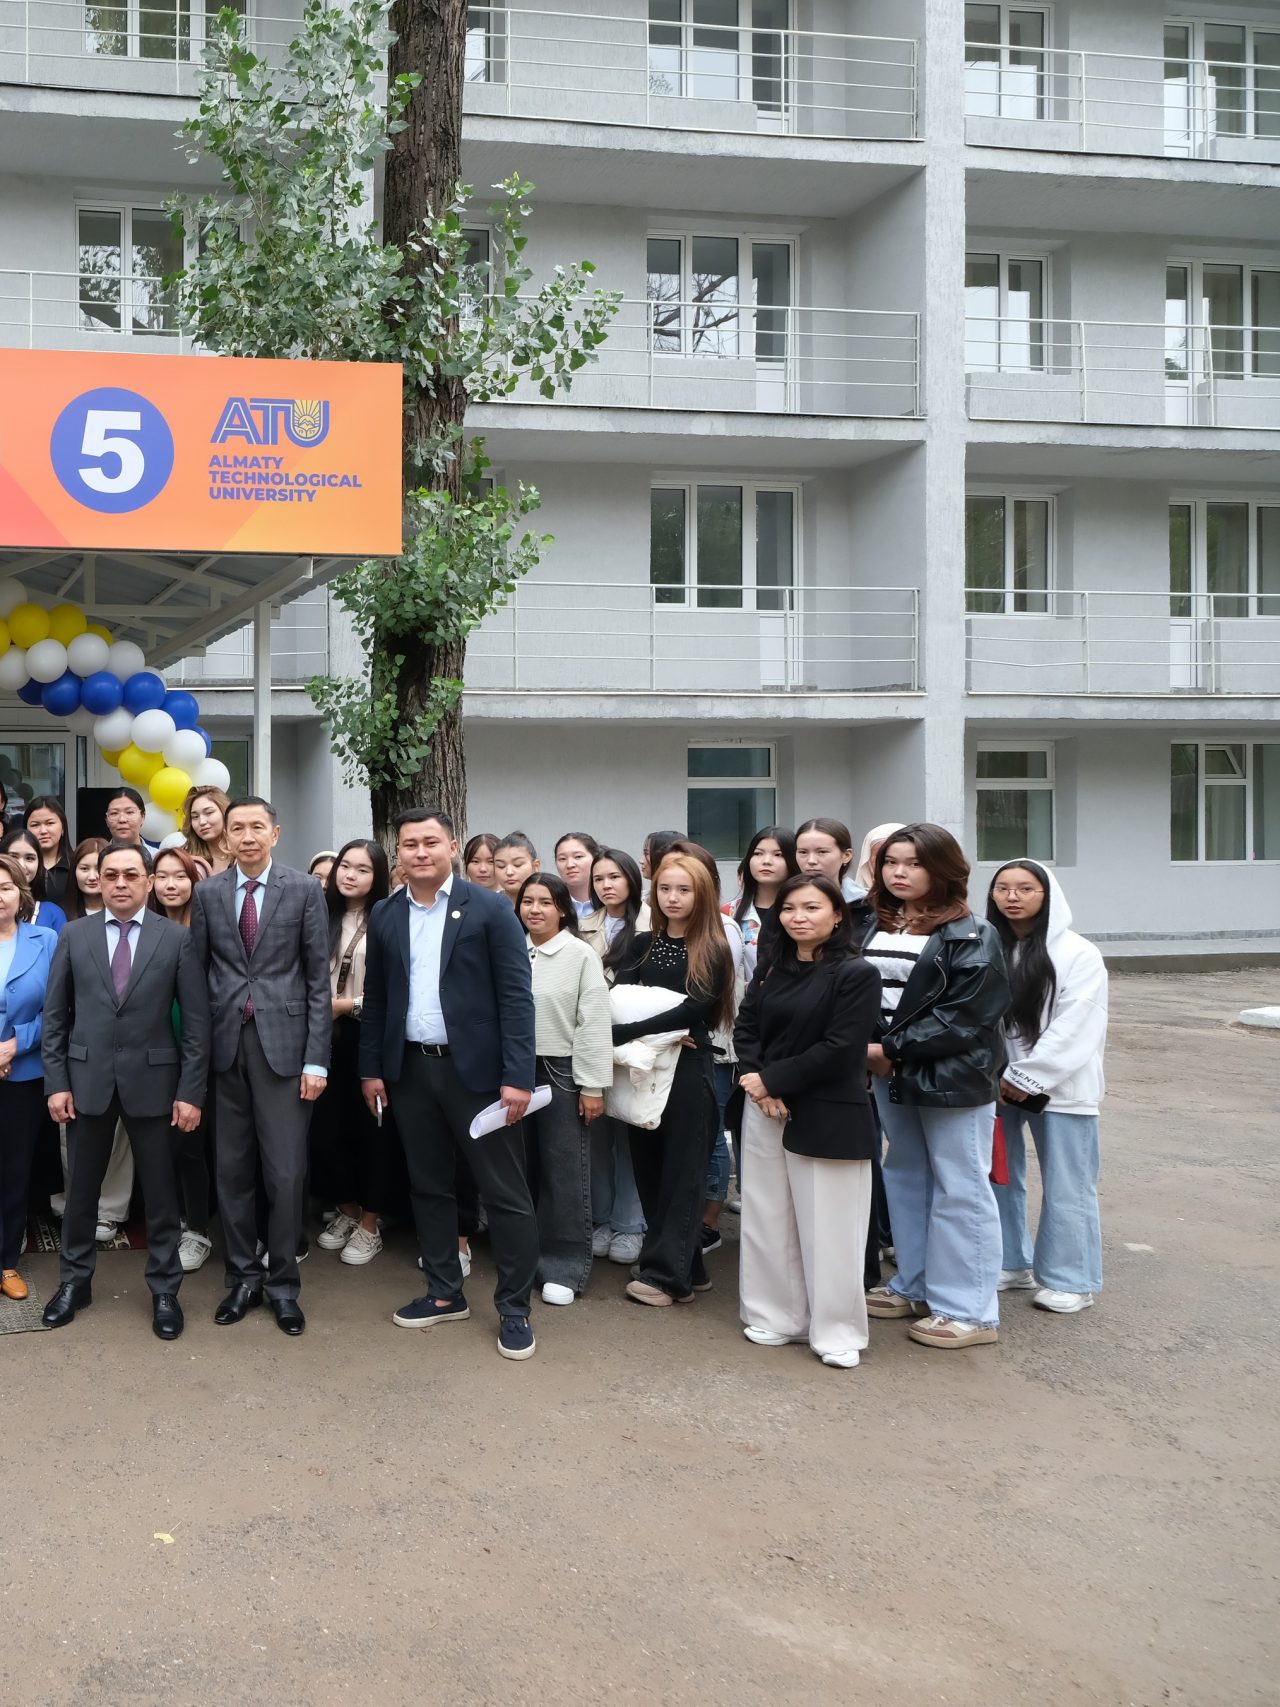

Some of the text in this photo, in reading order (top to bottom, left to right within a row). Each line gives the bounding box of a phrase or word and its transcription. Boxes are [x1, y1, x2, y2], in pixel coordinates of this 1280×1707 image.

[209, 397, 330, 448] ATU
[78, 409, 145, 494] 5
[208, 454, 284, 469] ALMATY
[208, 470, 363, 488] TECHNOLOGICAL
[209, 487, 317, 502] UNIVERSITY
